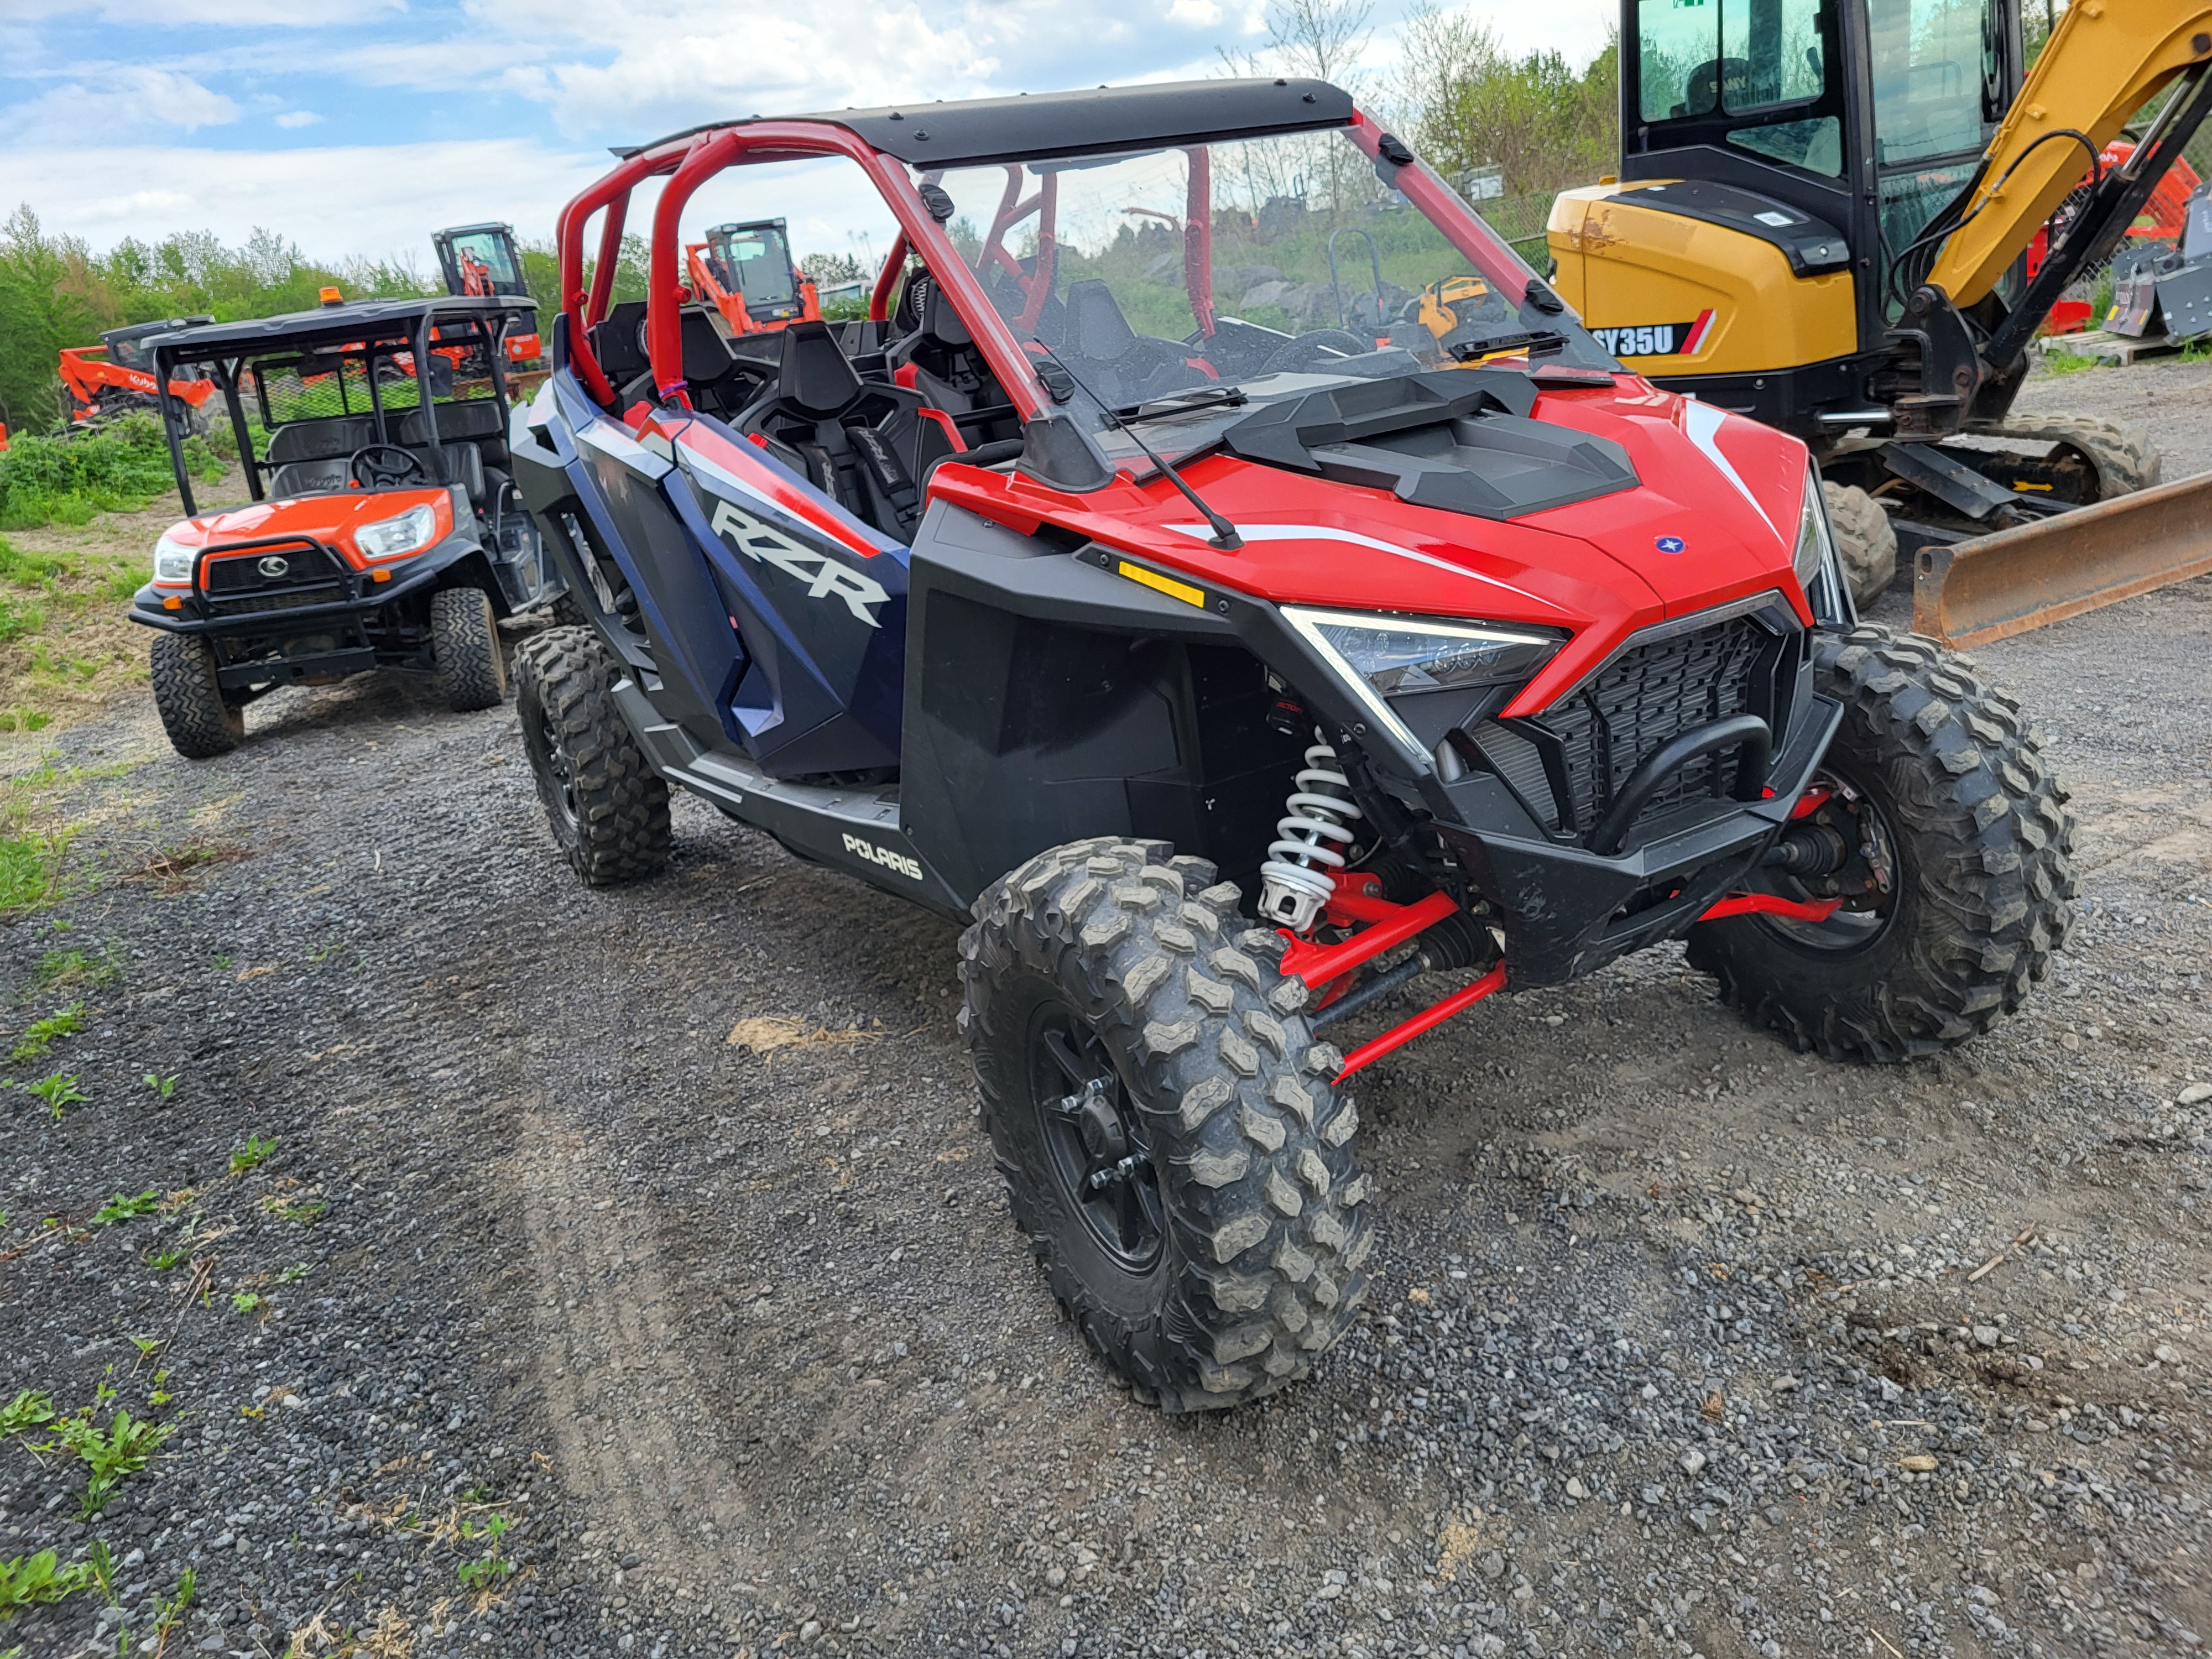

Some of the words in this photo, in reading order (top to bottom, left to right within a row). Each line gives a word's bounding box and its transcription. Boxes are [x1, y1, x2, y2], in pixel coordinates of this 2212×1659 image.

[1592, 325, 1673, 356] SY35U
[711, 499, 891, 628] RZR
[842, 832, 924, 881] POLARIS
